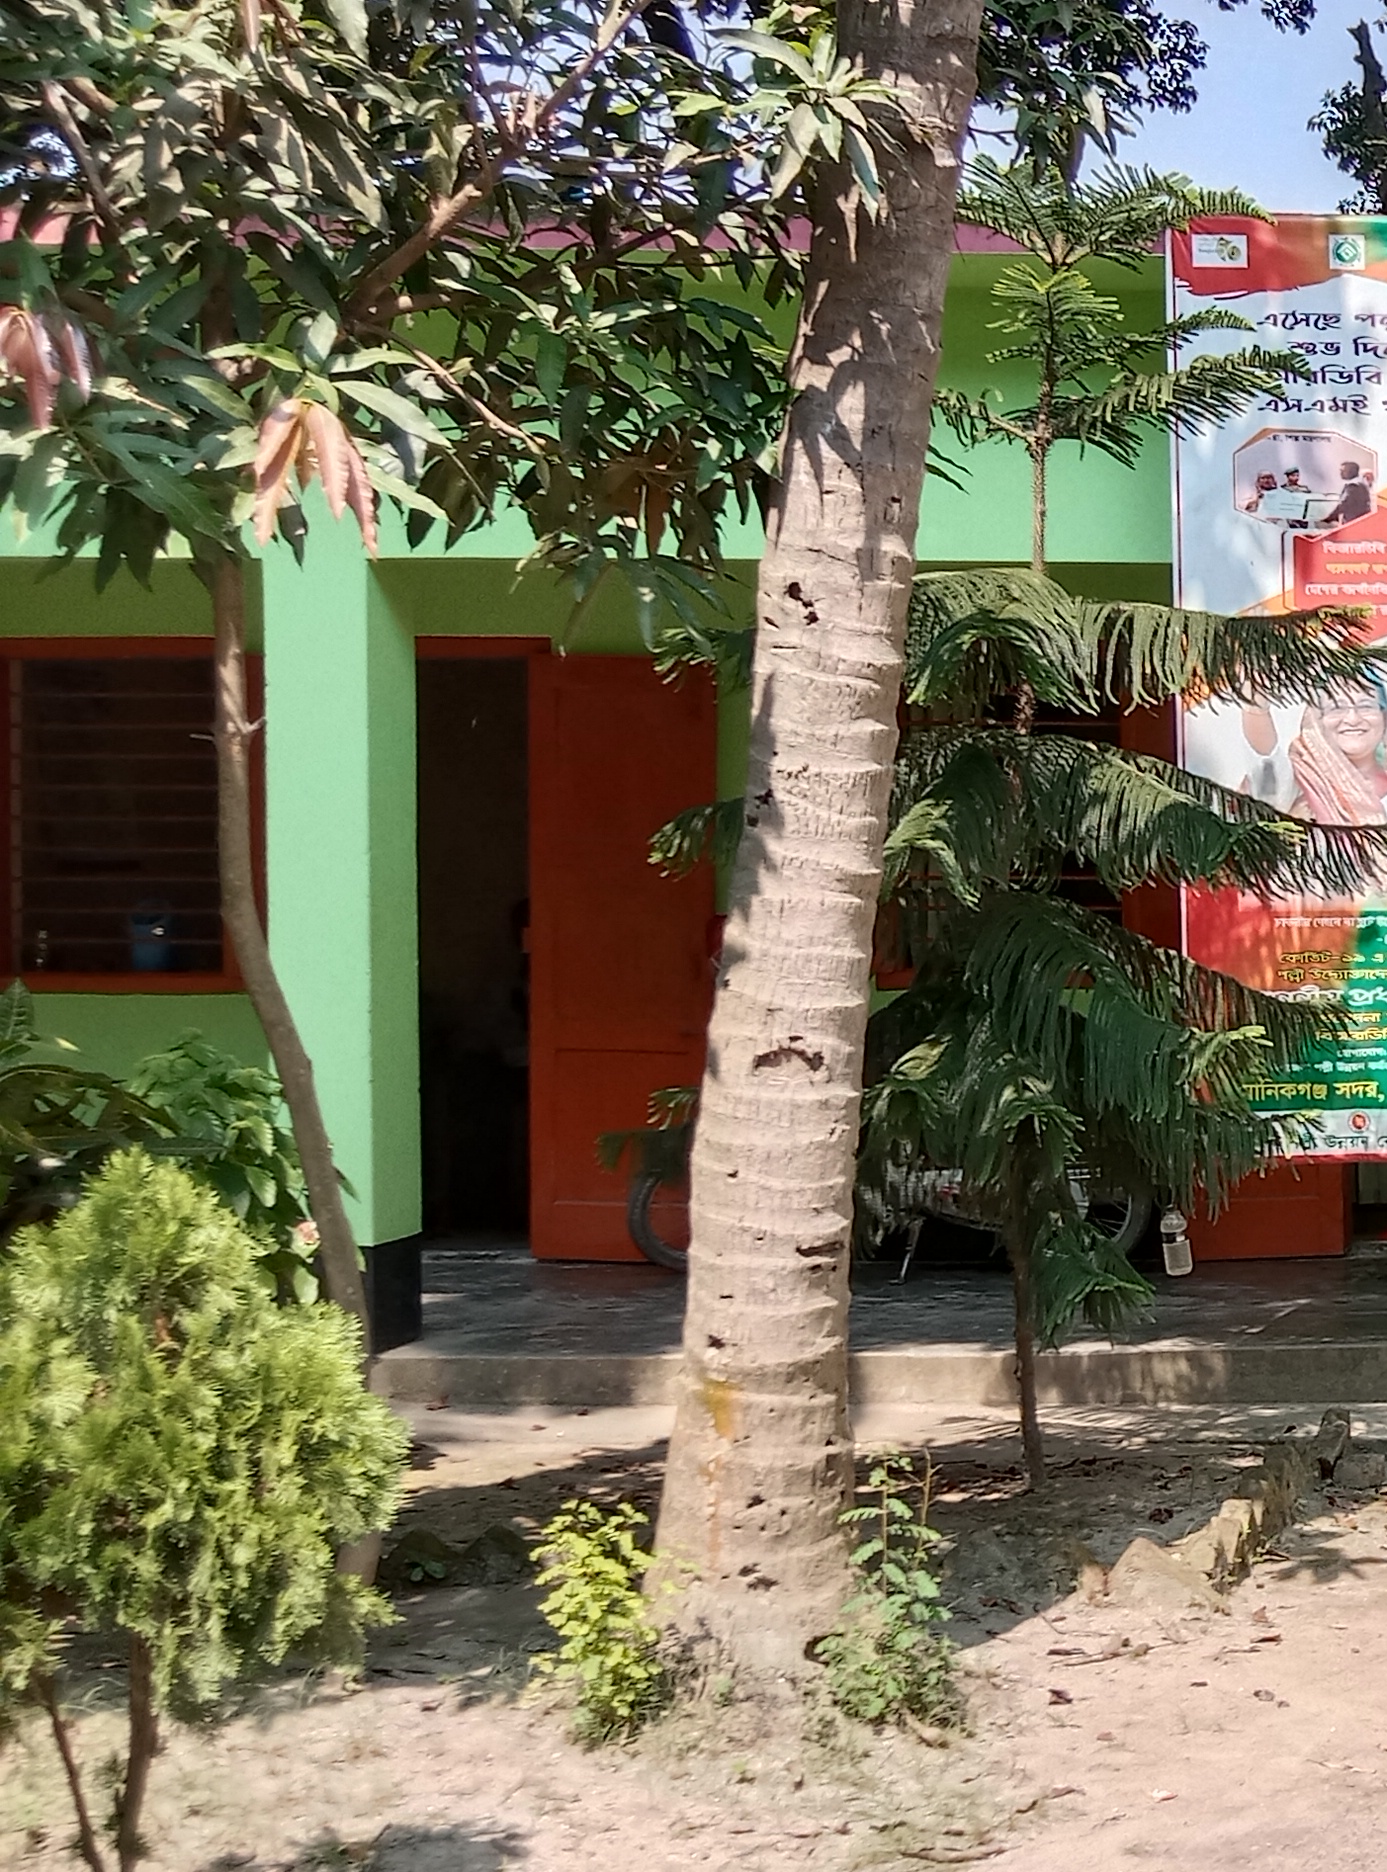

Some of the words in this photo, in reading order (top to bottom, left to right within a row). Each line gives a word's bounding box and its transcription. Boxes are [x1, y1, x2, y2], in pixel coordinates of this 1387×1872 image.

[1257, 309, 1342, 331] এসেছে
[1288, 340, 1342, 357] শুভ
[1258, 394, 1372, 416] এসএমই
